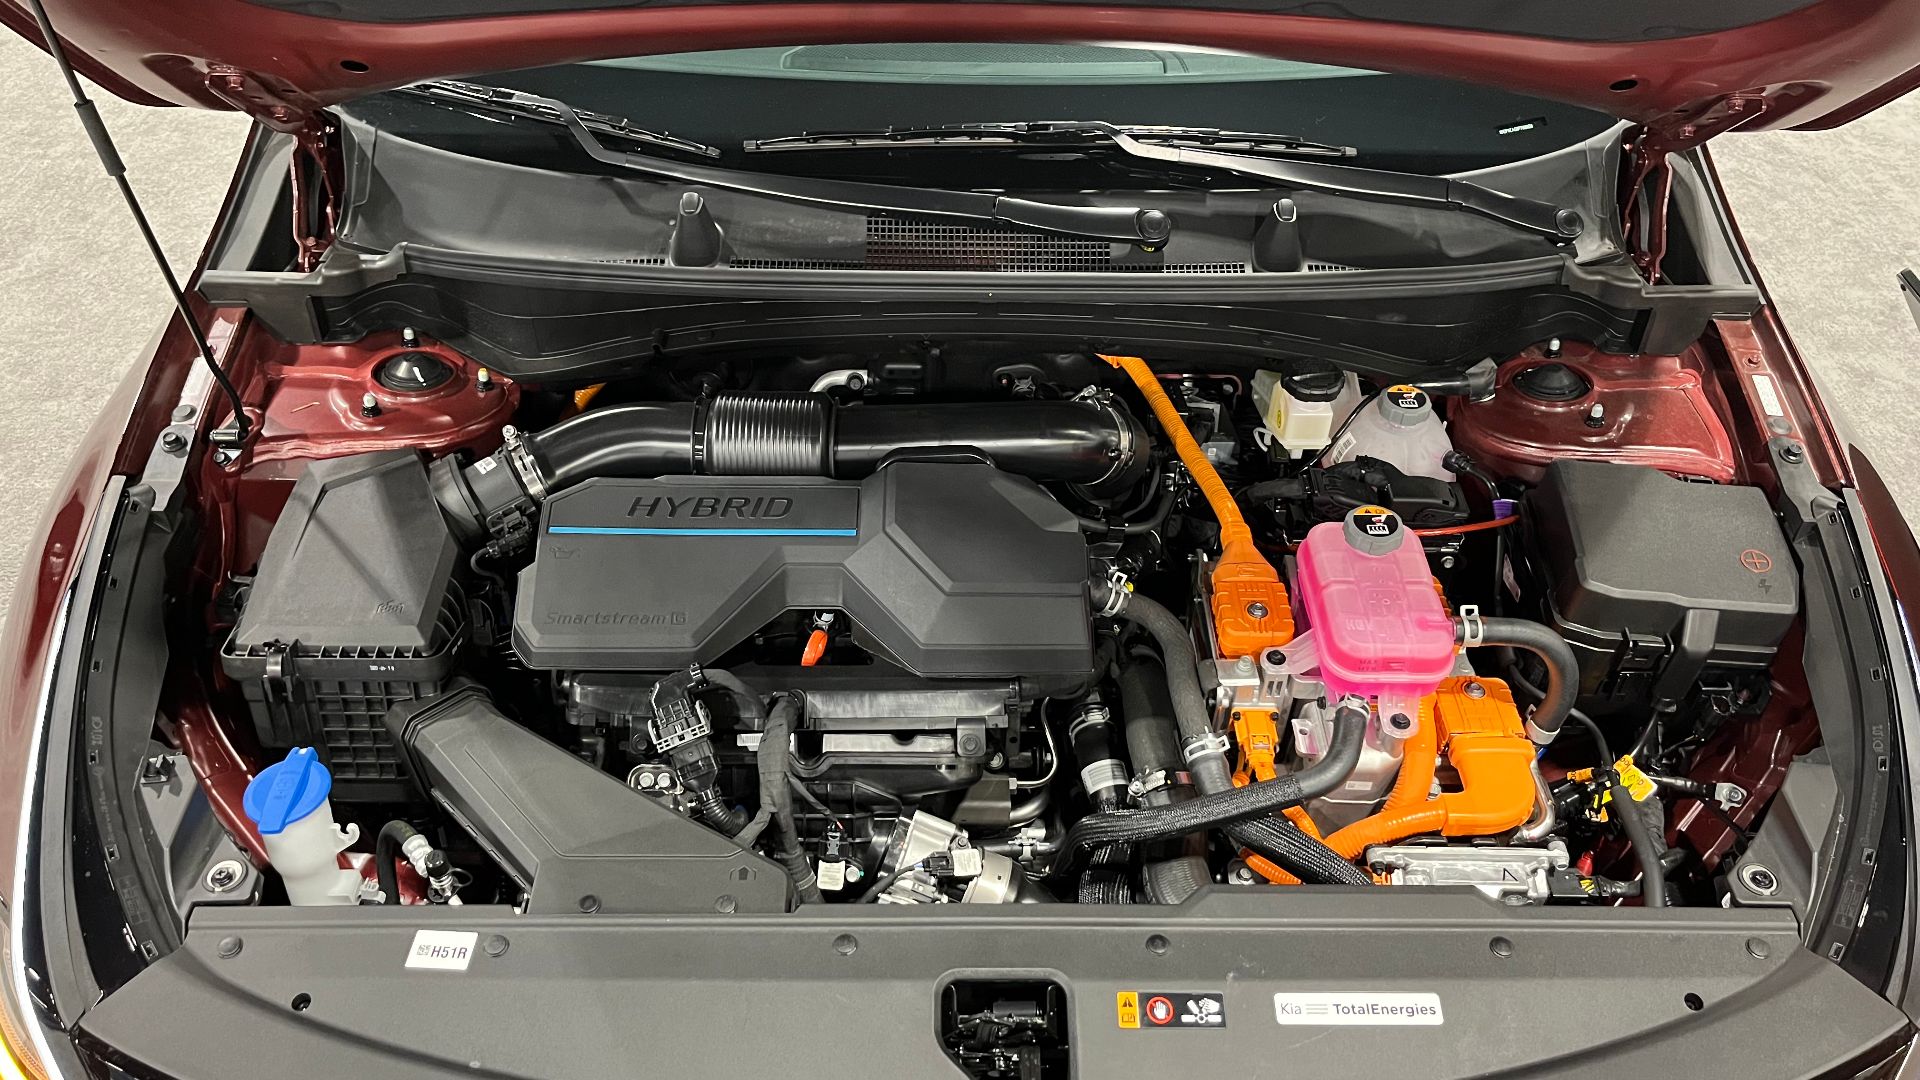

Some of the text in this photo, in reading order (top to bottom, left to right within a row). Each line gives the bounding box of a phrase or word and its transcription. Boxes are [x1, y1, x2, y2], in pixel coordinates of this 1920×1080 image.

[627, 496, 794, 519] HYBRID
[545, 611, 666, 625] Smartstream
[430, 945, 468, 960] H51R
[1280, 1002, 1437, 1018] Kia TotalEnergies
